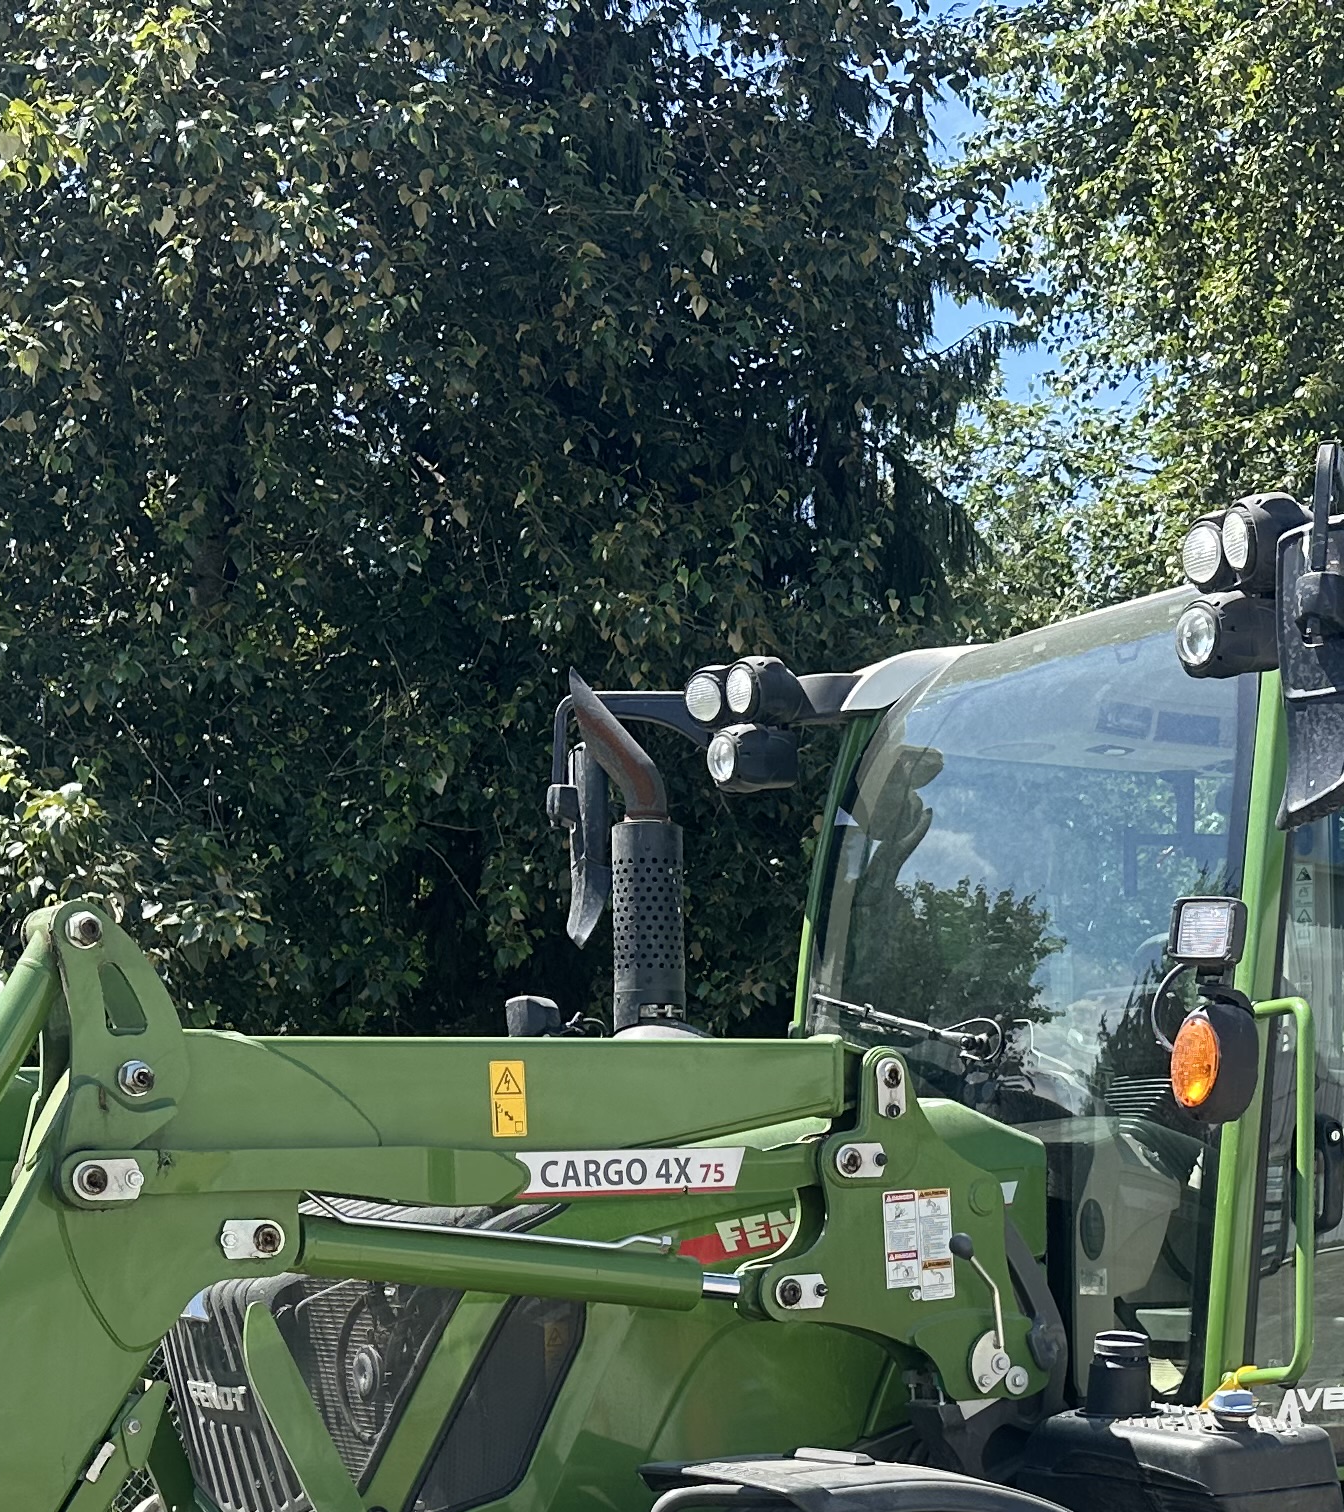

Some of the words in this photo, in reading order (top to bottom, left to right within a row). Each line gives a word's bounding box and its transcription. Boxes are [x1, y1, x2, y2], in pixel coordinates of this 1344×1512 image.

[540, 1158, 647, 1188] CARGO
[656, 1157, 693, 1185] 4X
[699, 1163, 725, 1183] 75
[186, 1379, 248, 1412] FENDT
